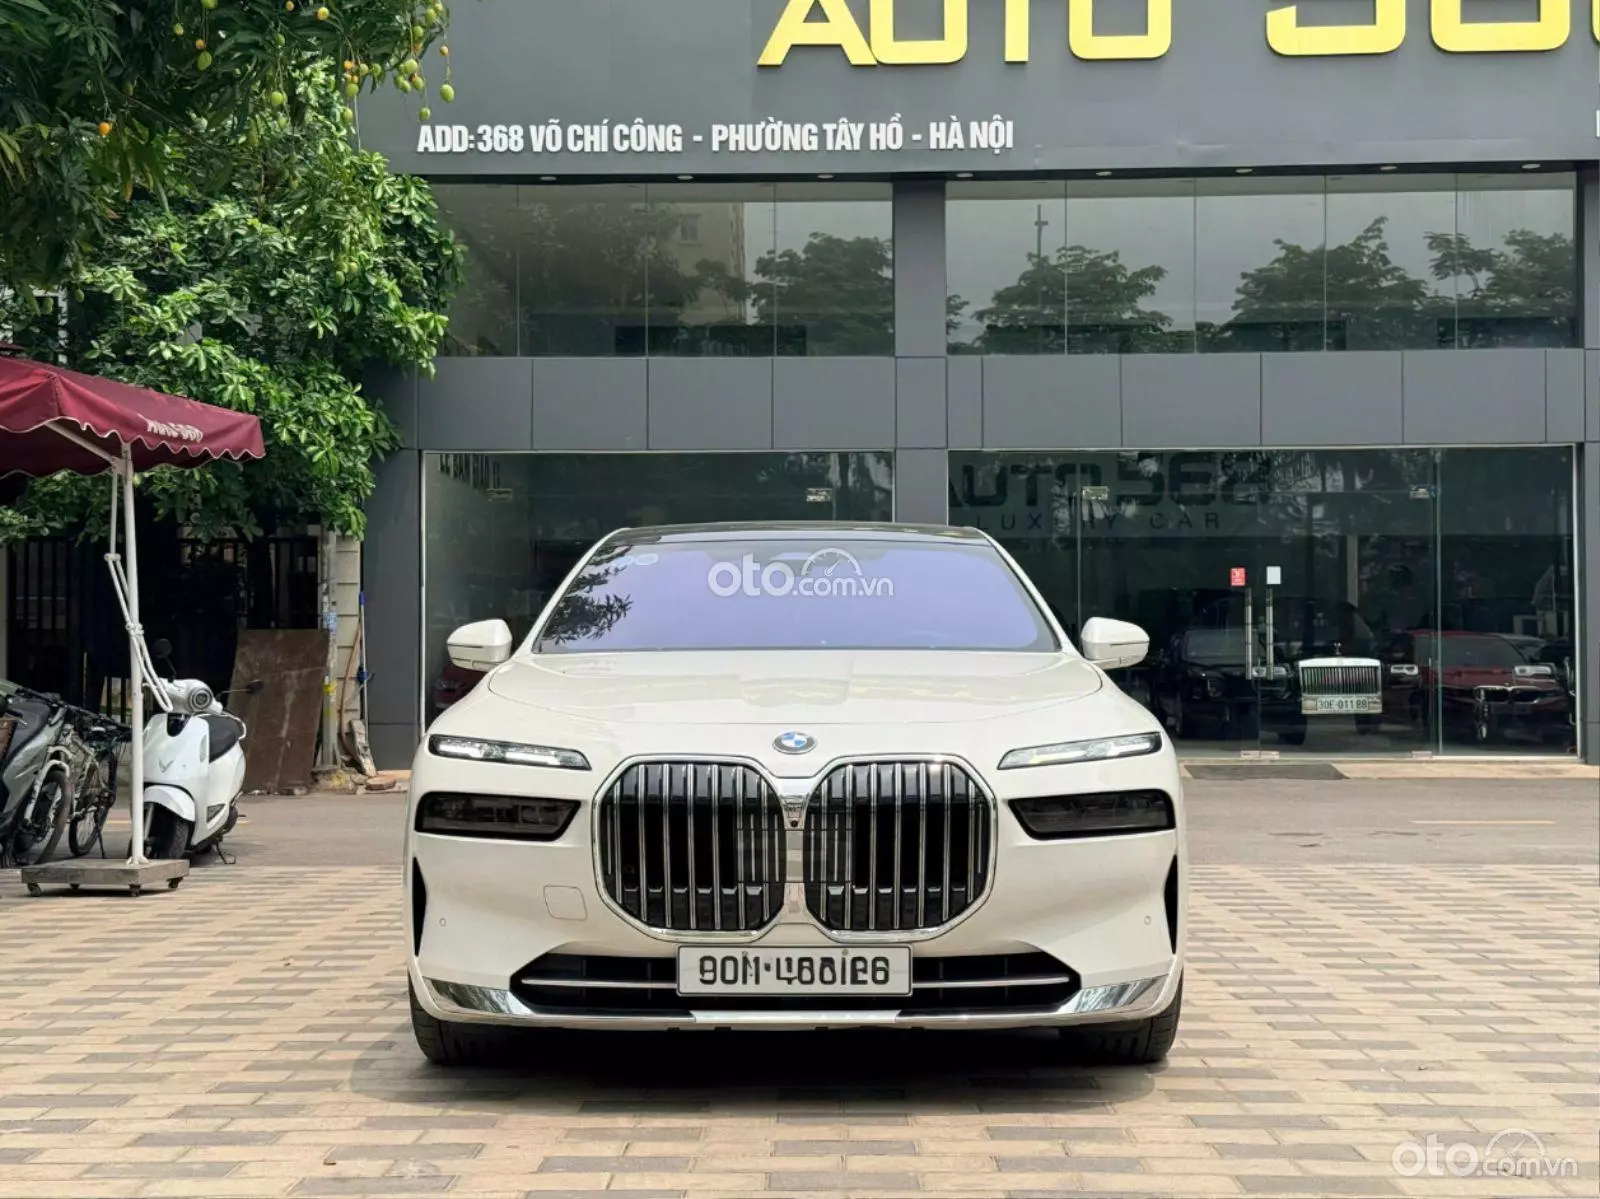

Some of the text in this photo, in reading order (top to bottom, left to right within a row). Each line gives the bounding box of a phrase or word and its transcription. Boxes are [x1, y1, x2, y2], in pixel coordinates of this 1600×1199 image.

[529, 119, 562, 152] VÕ
[567, 119, 609, 152] CHÍ
[612, 118, 683, 152] CÔNG
[712, 117, 818, 151] PHƯỜNG
[822, 117, 864, 150] TÂY
[869, 113, 903, 150] HỒ
[929, 115, 964, 149] HÀ
[969, 114, 1014, 154] NỘI
[1150, 511, 1219, 530] CAR
